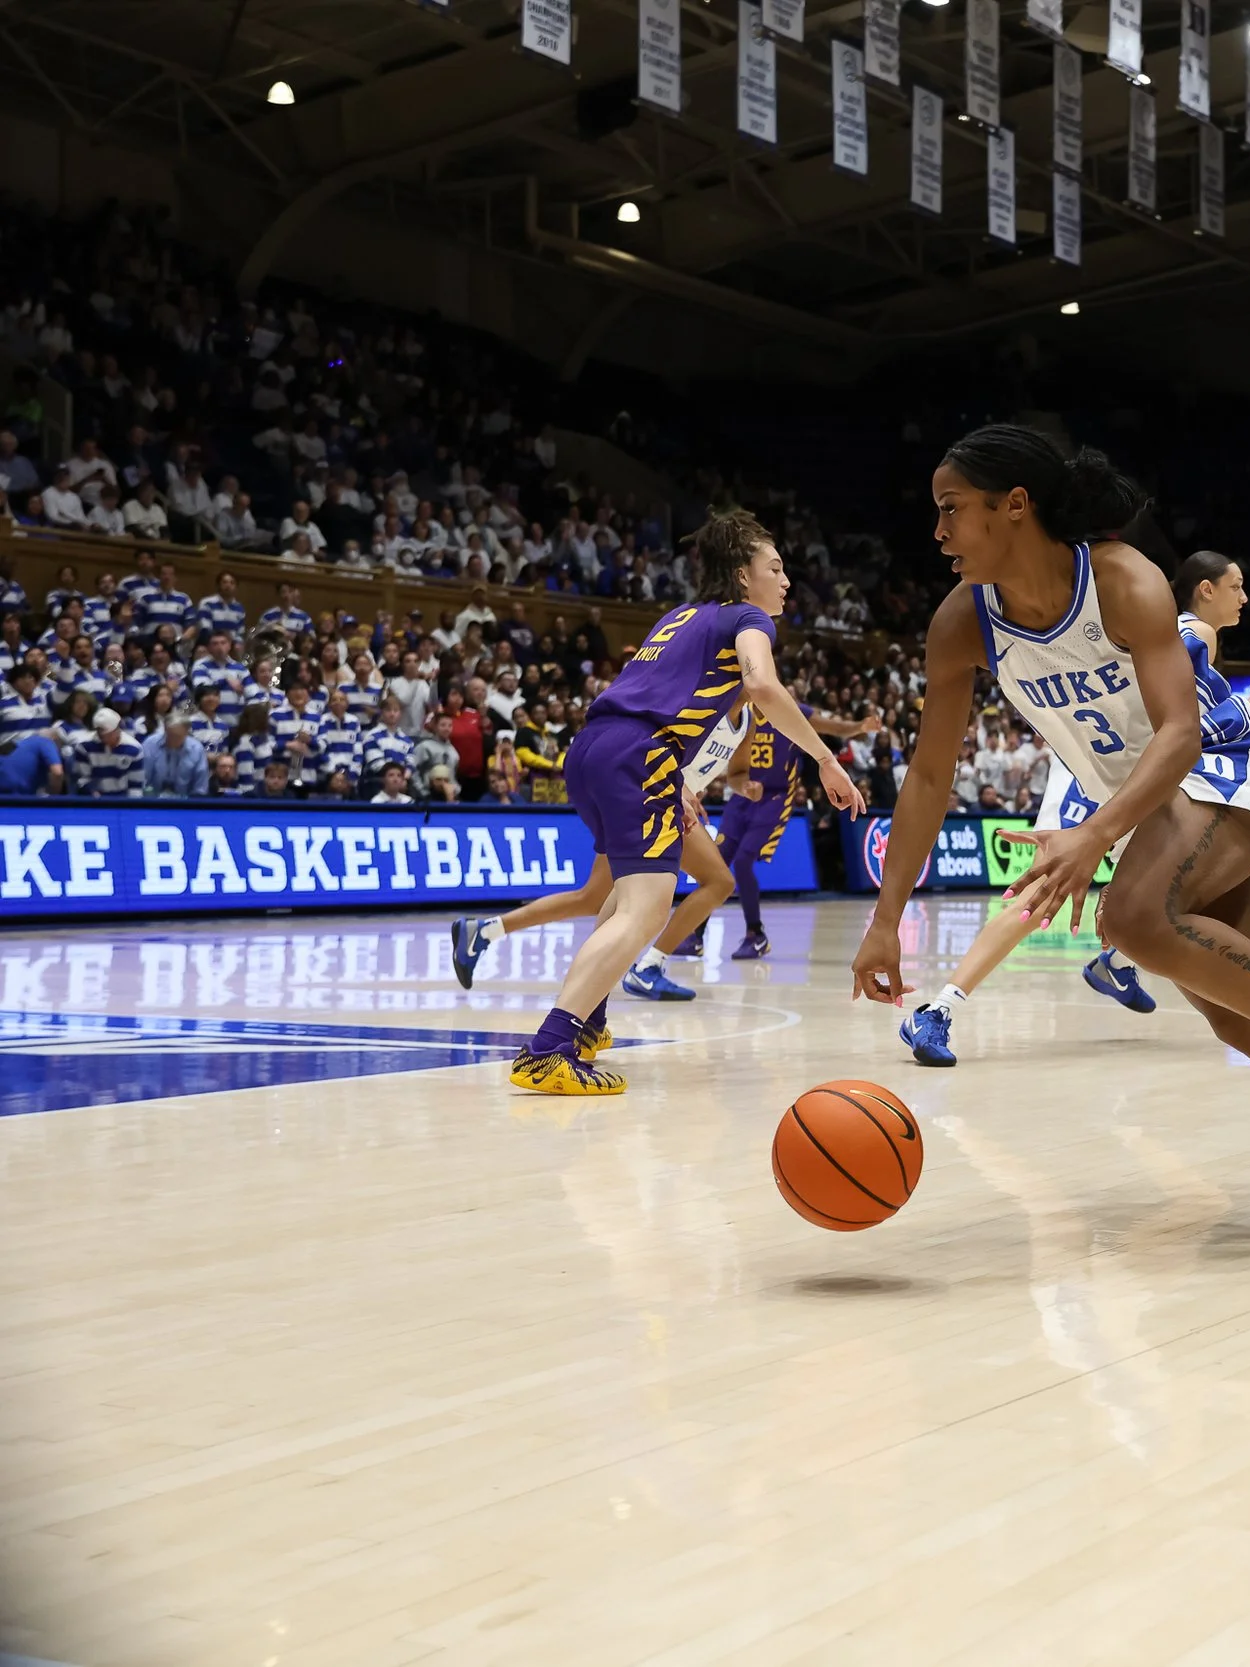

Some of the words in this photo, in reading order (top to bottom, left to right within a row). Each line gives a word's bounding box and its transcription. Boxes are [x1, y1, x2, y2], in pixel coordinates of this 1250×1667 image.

[650, 607, 697, 642] 2
[631, 646, 665, 661] KNOX
[1016, 660, 1130, 708] DUKE
[1073, 709, 1125, 754] 3
[706, 740, 735, 760] DUK
[750, 744, 773, 769] 23
[698, 759, 718, 776] 4
[937, 830, 948, 850] a
[950, 824, 978, 850] sub
[0, 825, 115, 898] KE
[135, 825, 575, 896] BASKETBALL
[937, 851, 982, 876] above
